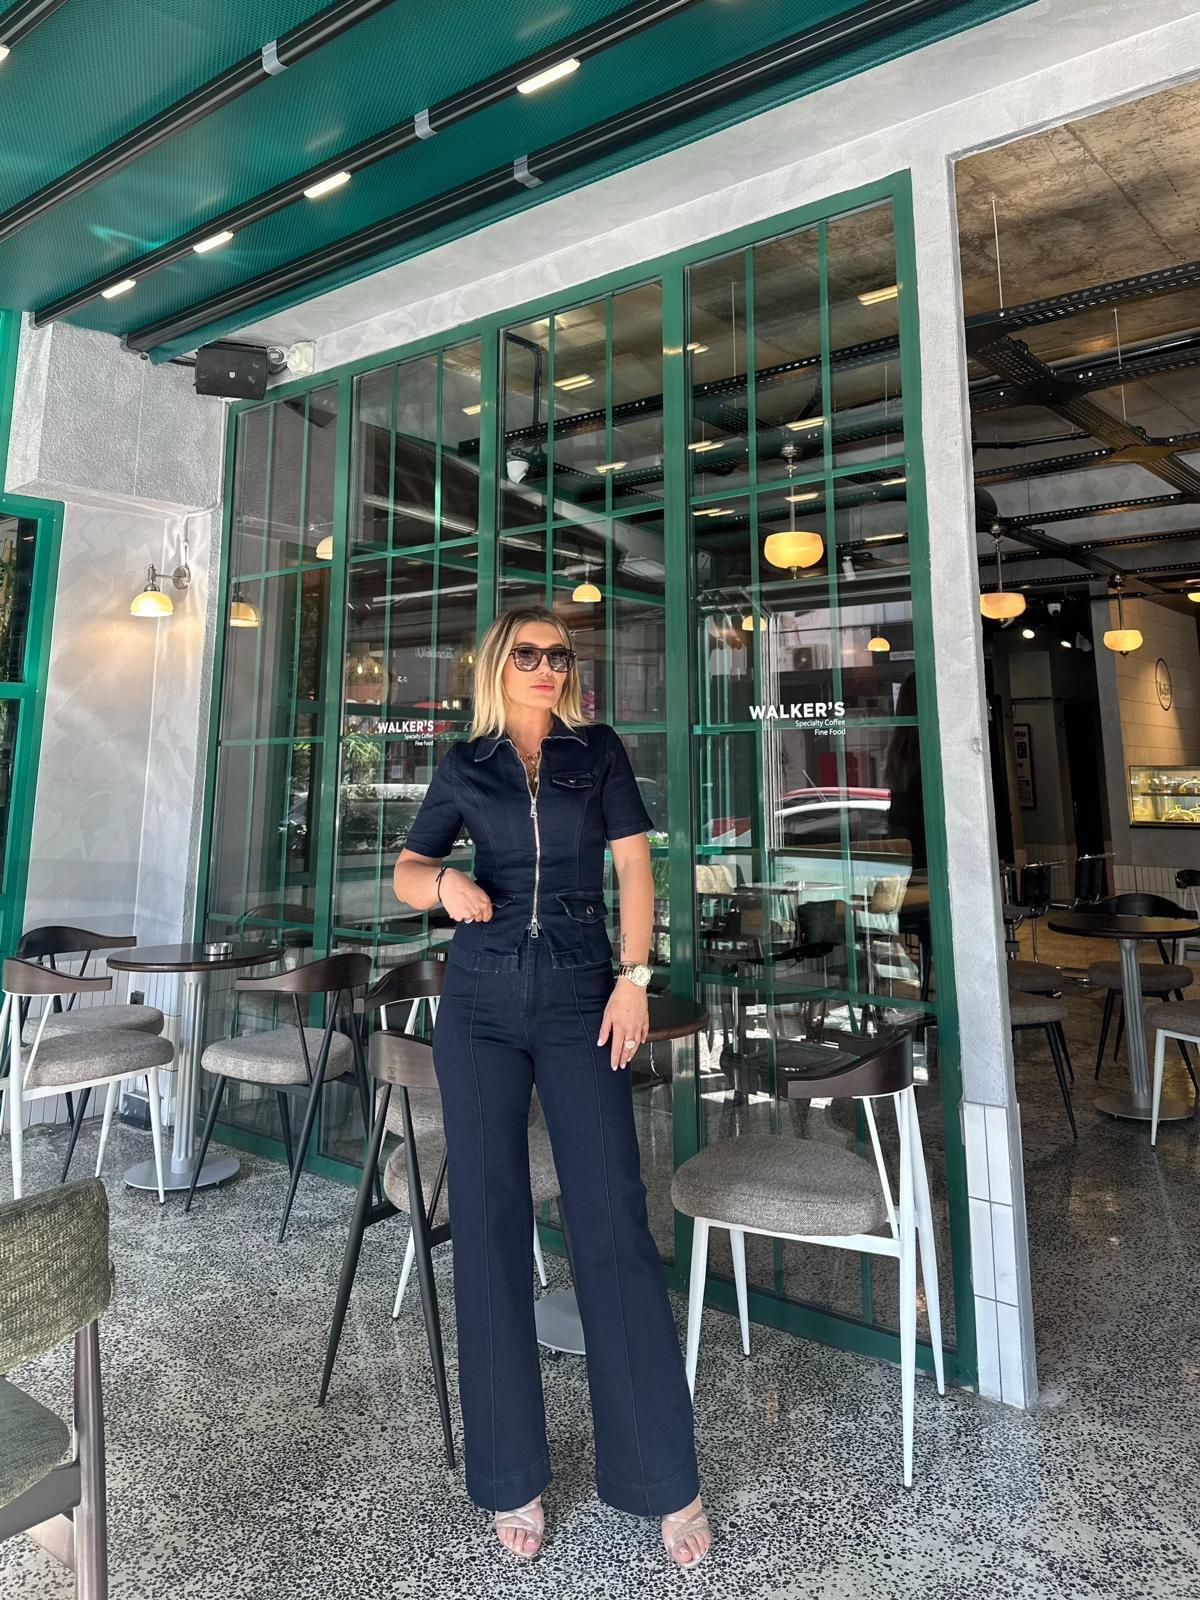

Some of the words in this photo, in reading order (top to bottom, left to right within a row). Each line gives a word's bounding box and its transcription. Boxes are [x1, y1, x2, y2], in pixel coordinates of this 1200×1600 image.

[749, 702, 845, 720] WALKER'S
[377, 720, 434, 734] WALKER'S
[795, 720, 824, 728] Specialty
[824, 718, 846, 726] Coffee
[814, 728, 829, 736] Fine
[829, 728, 846, 736] Food
